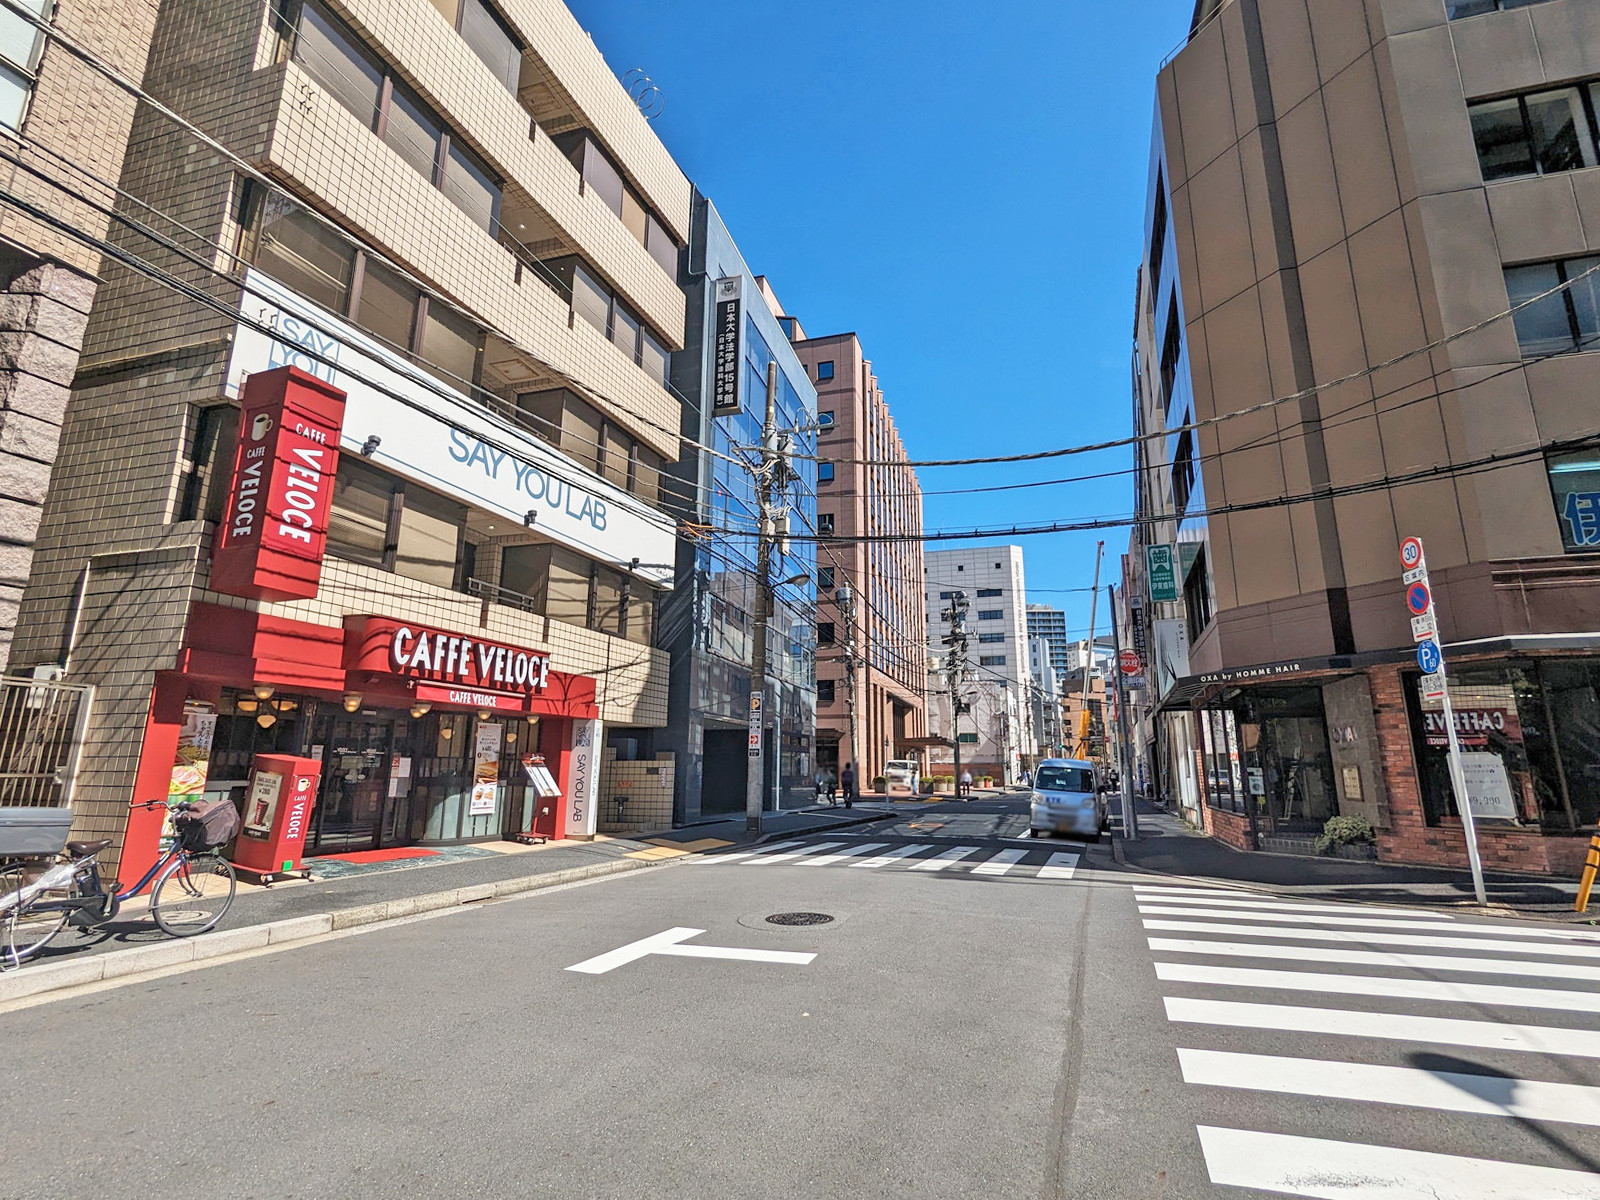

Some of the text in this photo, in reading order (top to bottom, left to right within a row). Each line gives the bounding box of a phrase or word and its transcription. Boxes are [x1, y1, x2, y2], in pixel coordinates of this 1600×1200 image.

[283, 318, 334, 355] SAY
[724, 303, 735, 404] 日本大学法学部15号館
[448, 428, 606, 531] SAY YOU LAB
[233, 460, 263, 537] VELOCE
[279, 448, 323, 543] VELOCE
[1405, 545, 1416, 560] 30
[478, 644, 549, 688] VELOCE
[1421, 648, 1431, 669] P
[1429, 658, 1436, 668] 60
[1236, 668, 1271, 678] HOMME
[1275, 664, 1300, 672] HAIR
[472, 693, 496, 707] VELOCE
[751, 698, 760, 710] P
[577, 754, 586, 774] SAY
[575, 775, 585, 798] YOU
[287, 803, 304, 839] VELOCE
[573, 800, 582, 822] LAB
